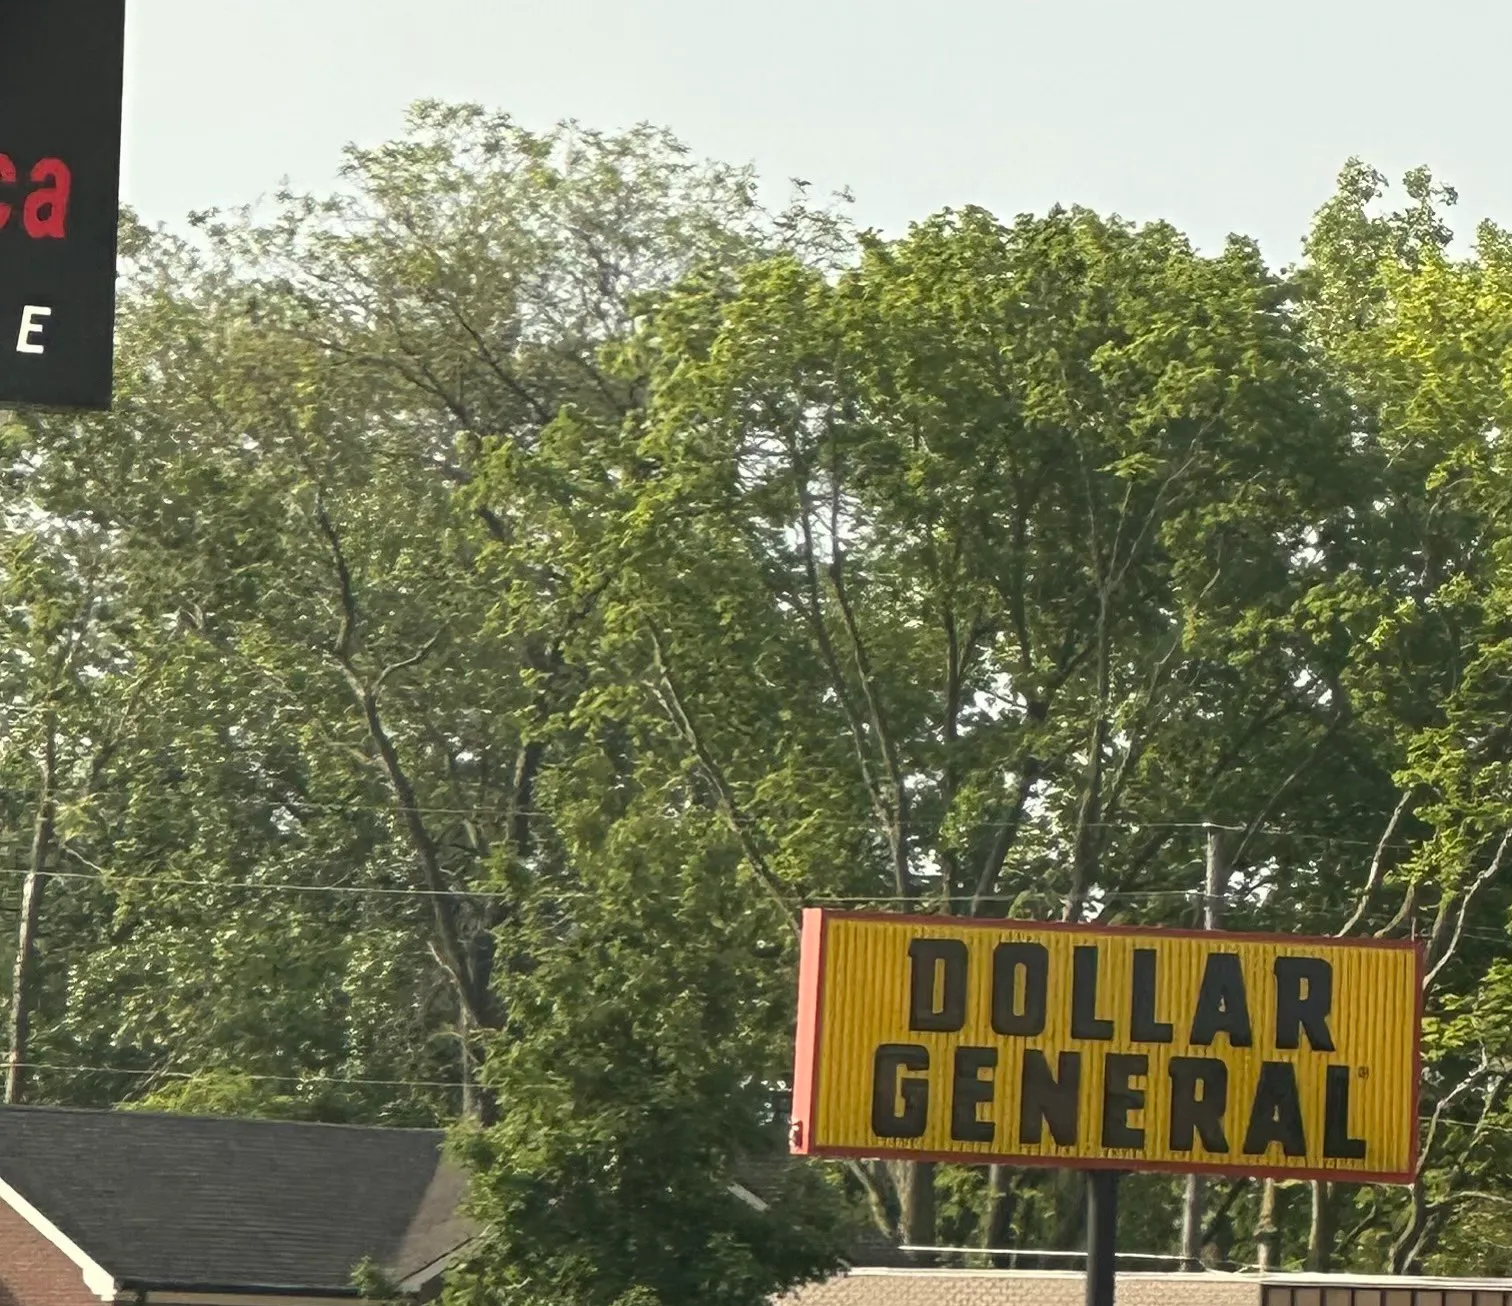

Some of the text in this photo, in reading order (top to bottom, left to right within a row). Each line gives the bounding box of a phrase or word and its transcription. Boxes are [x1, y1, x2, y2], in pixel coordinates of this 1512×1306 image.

[16, 305, 51, 354] E
[908, 937, 1336, 1052] DOLLAR
[870, 1042, 1367, 1160] GENERAL
